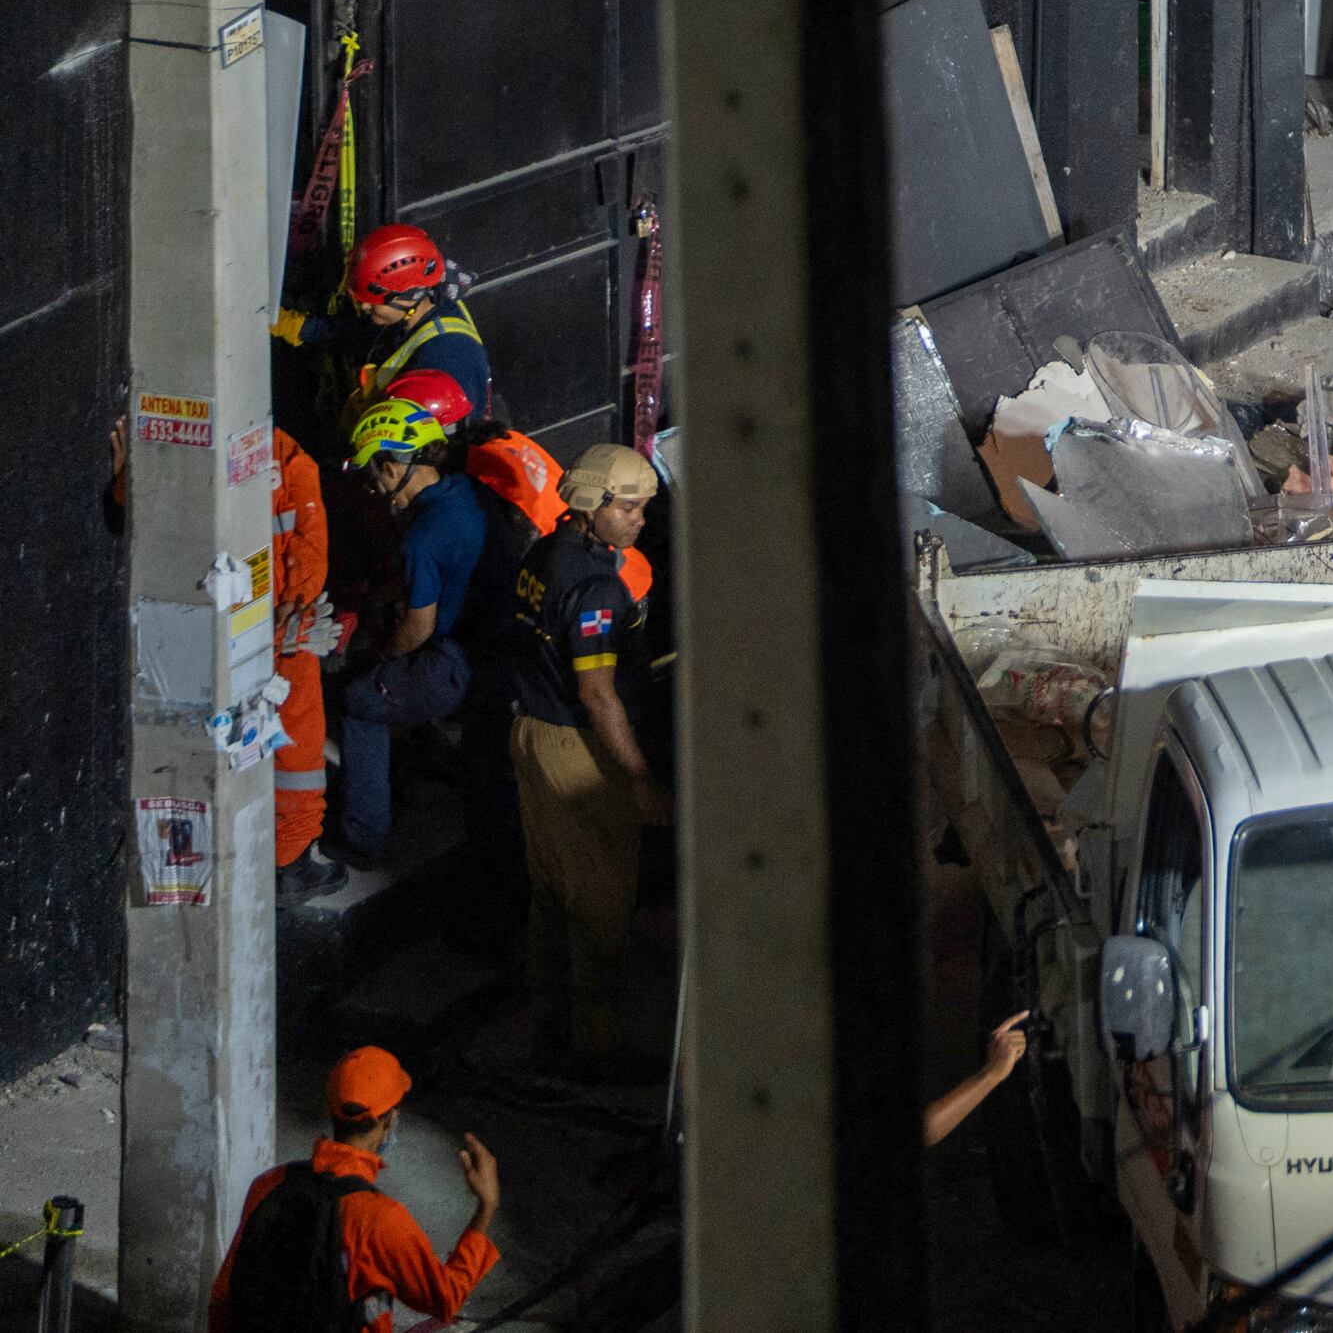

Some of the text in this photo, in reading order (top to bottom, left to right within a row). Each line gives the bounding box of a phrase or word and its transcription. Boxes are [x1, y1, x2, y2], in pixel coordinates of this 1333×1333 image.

[140, 396, 209, 419] ANTENA TAXI
[149, 420, 209, 444] 533-4444
[515, 568, 547, 605] COE
